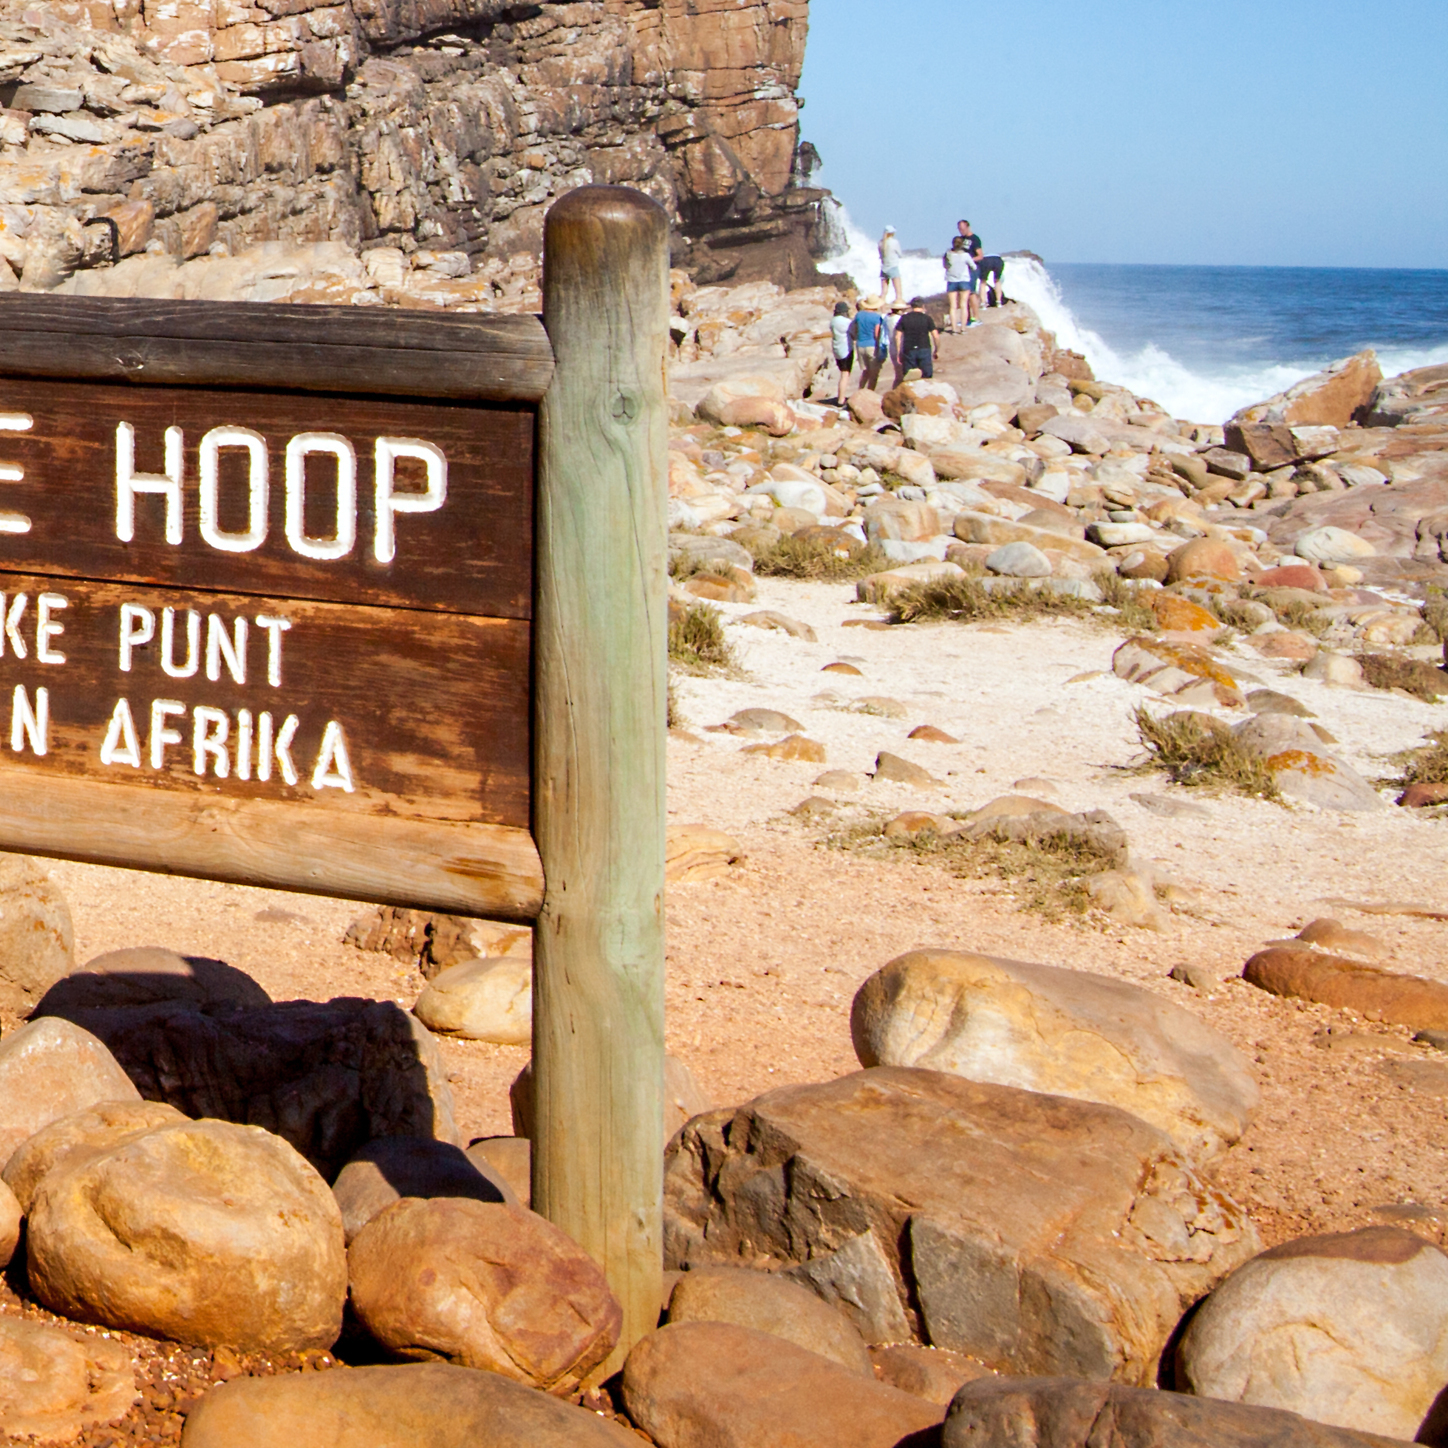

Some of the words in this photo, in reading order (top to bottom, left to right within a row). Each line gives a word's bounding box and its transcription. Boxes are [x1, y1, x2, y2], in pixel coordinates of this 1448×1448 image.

[115, 420, 448, 564] HOOP
[119, 602, 292, 688] PUNT
[99, 697, 356, 794] AFRIKA
